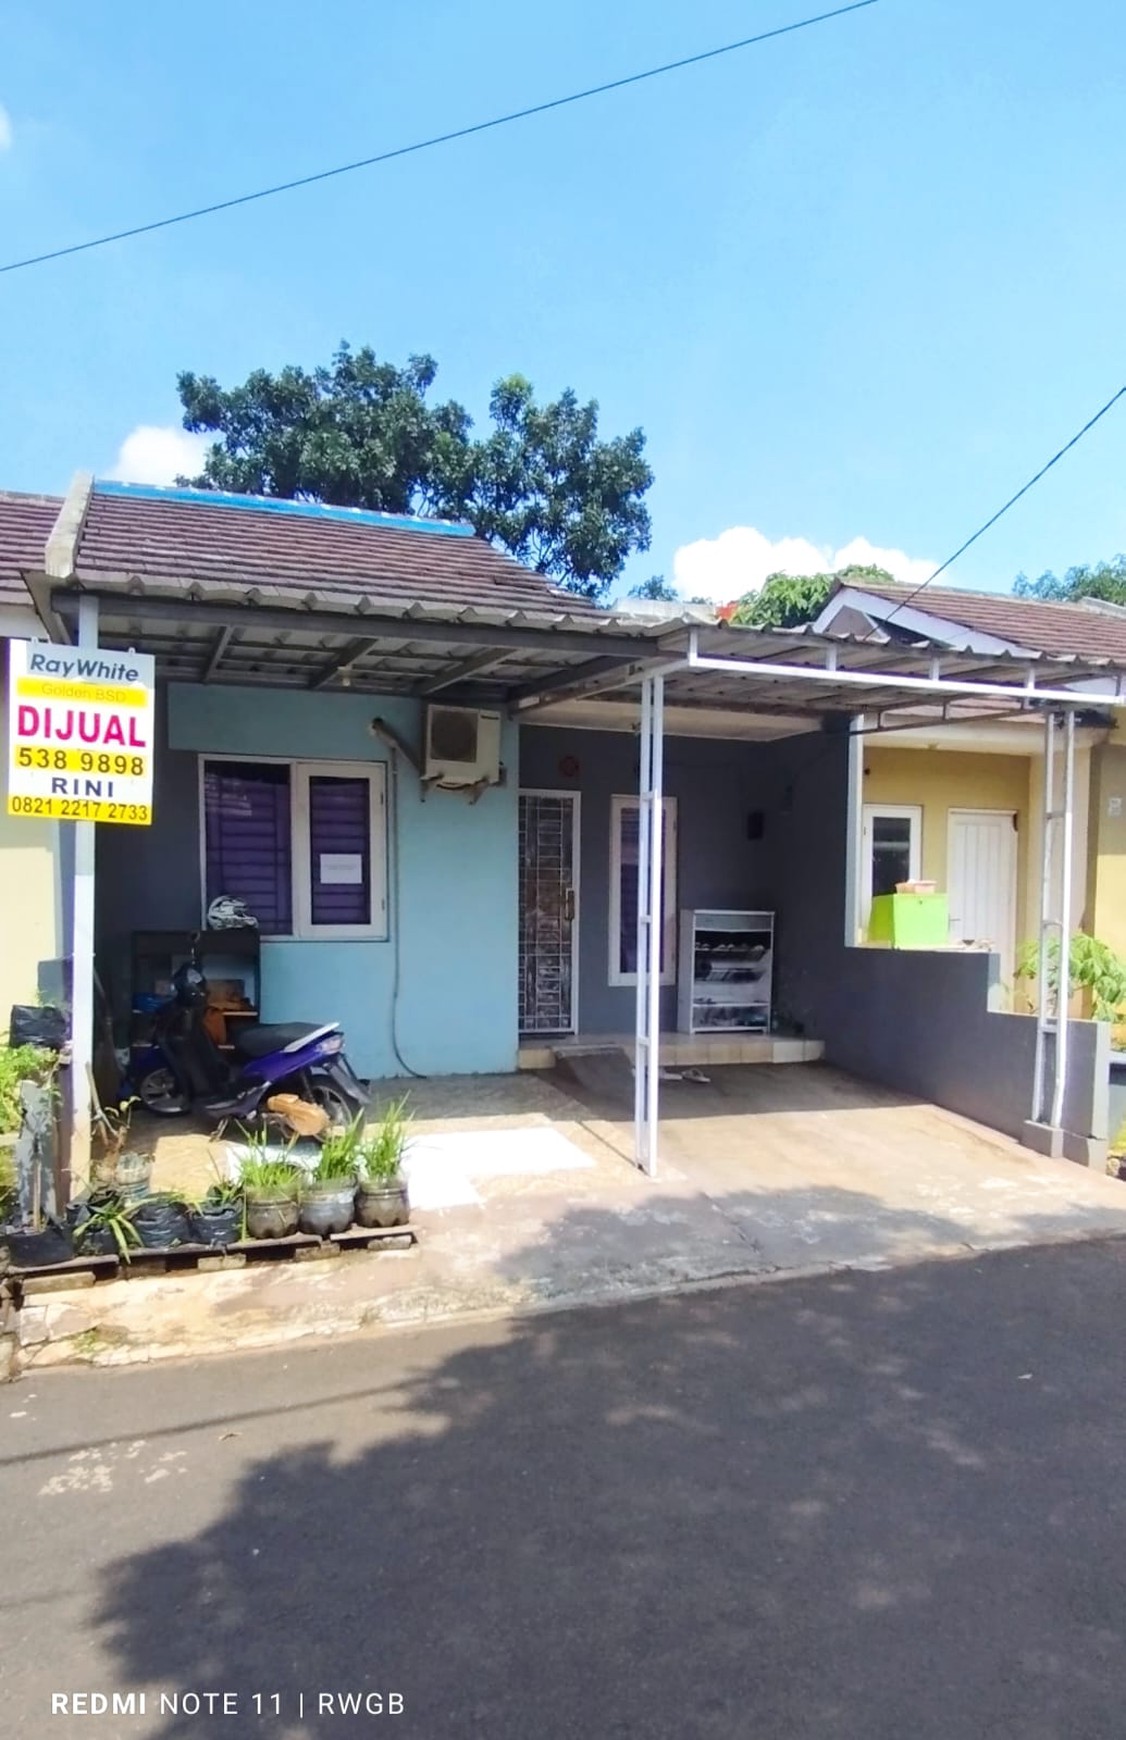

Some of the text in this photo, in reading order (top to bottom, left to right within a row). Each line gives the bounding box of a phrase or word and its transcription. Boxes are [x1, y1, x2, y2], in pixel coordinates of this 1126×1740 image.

[41, 683, 127, 703] Golden BSD
[17, 705, 147, 748] DIJUAL
[18, 747, 143, 776] 538 9898
[51, 777, 114, 798] RINI
[12, 796, 147, 821] 0821 2217 2733
